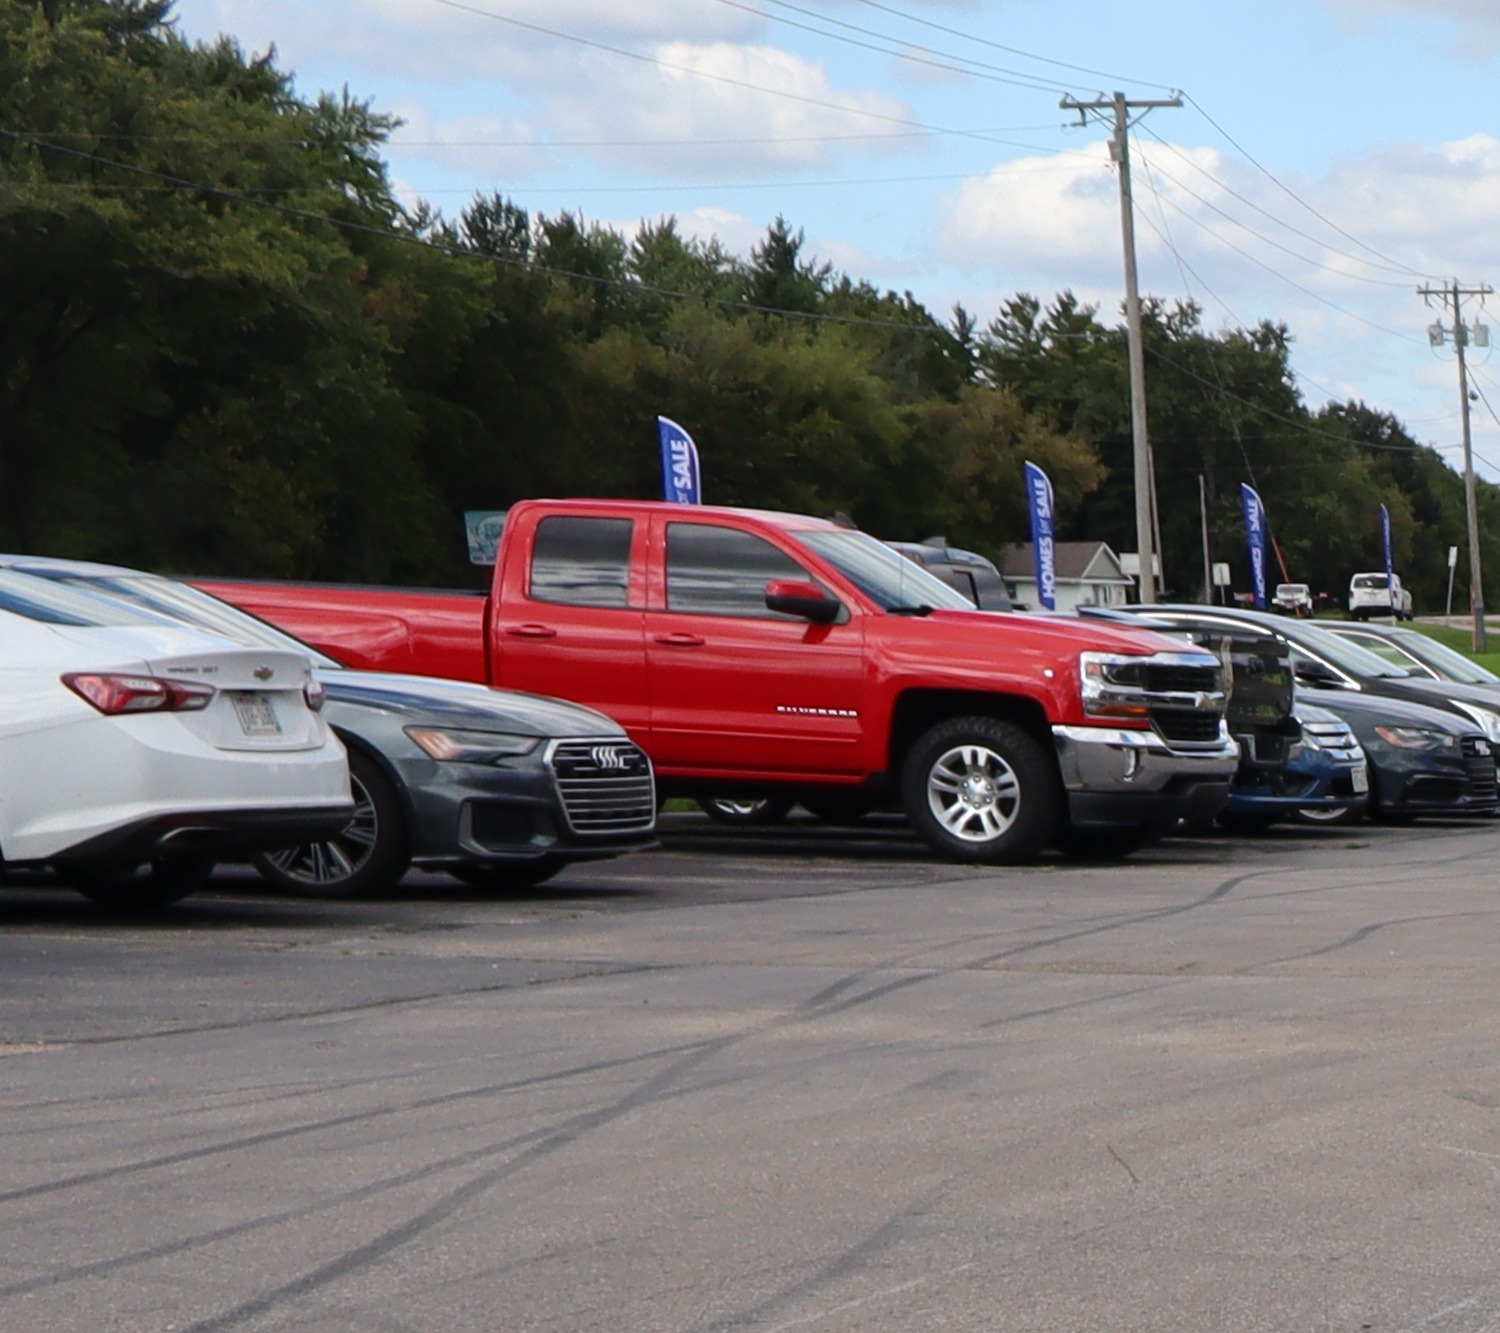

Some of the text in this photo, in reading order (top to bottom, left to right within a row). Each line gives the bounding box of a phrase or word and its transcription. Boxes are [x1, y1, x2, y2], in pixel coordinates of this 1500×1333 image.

[670, 439, 692, 490] SALE
[1033, 478, 1051, 518] SALE
[1038, 537, 1055, 599] HOMES
